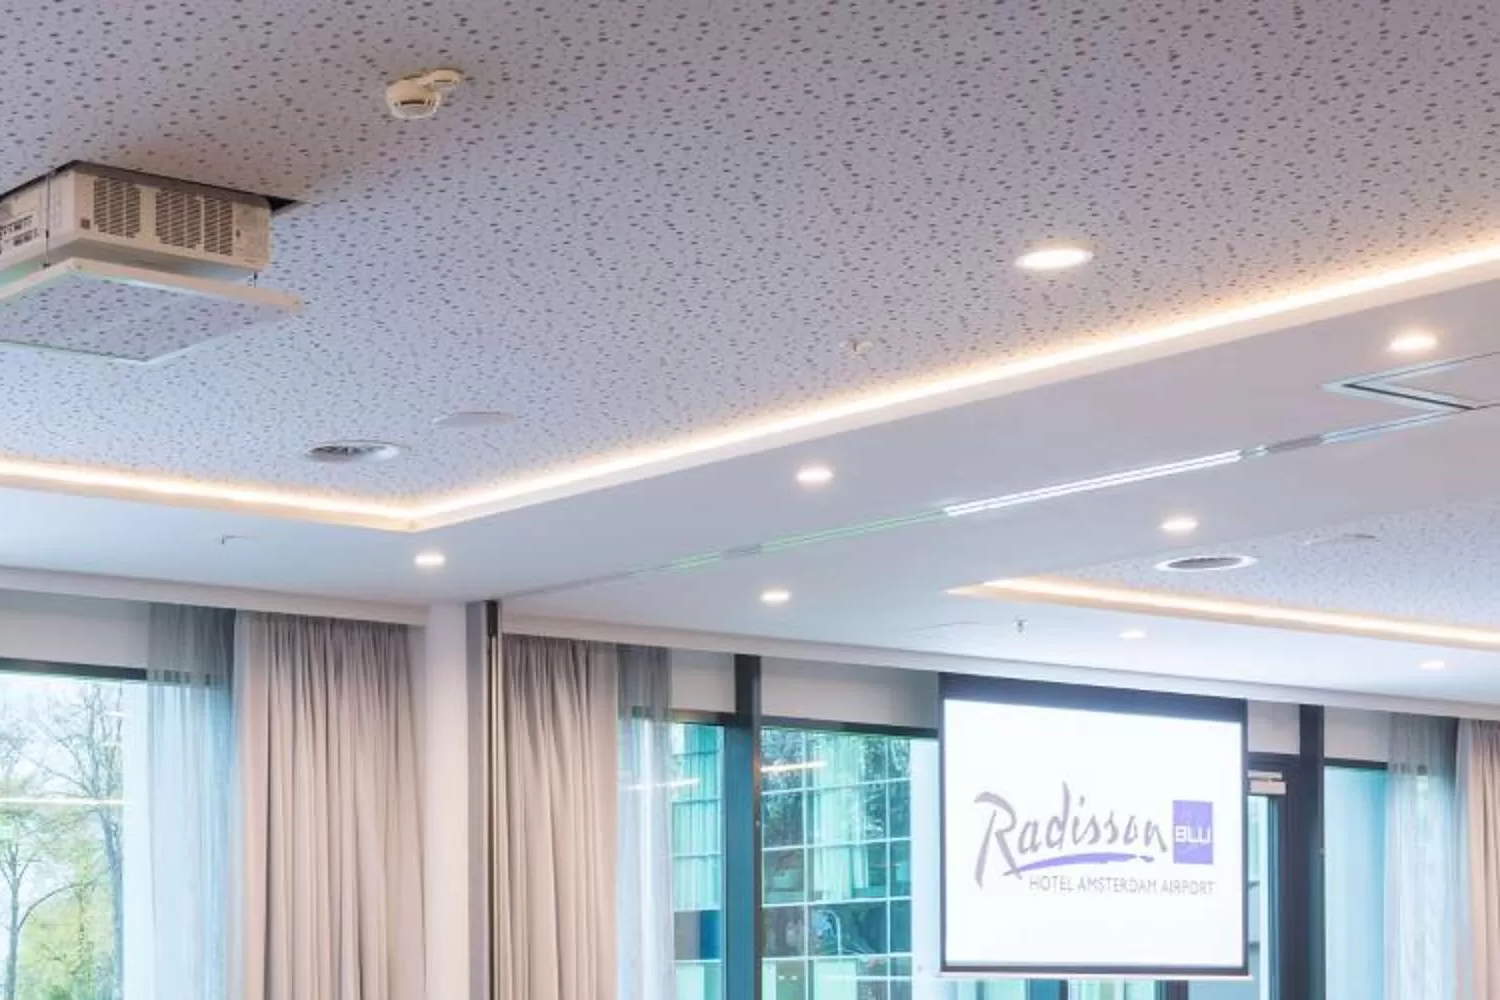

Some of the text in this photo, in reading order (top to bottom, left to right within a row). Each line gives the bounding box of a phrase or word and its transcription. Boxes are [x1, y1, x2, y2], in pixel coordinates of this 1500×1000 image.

[973, 781, 1212, 890] Radisson BLU
[1029, 875, 1216, 896] HOTEL AMSTERDAM AIRPORT
